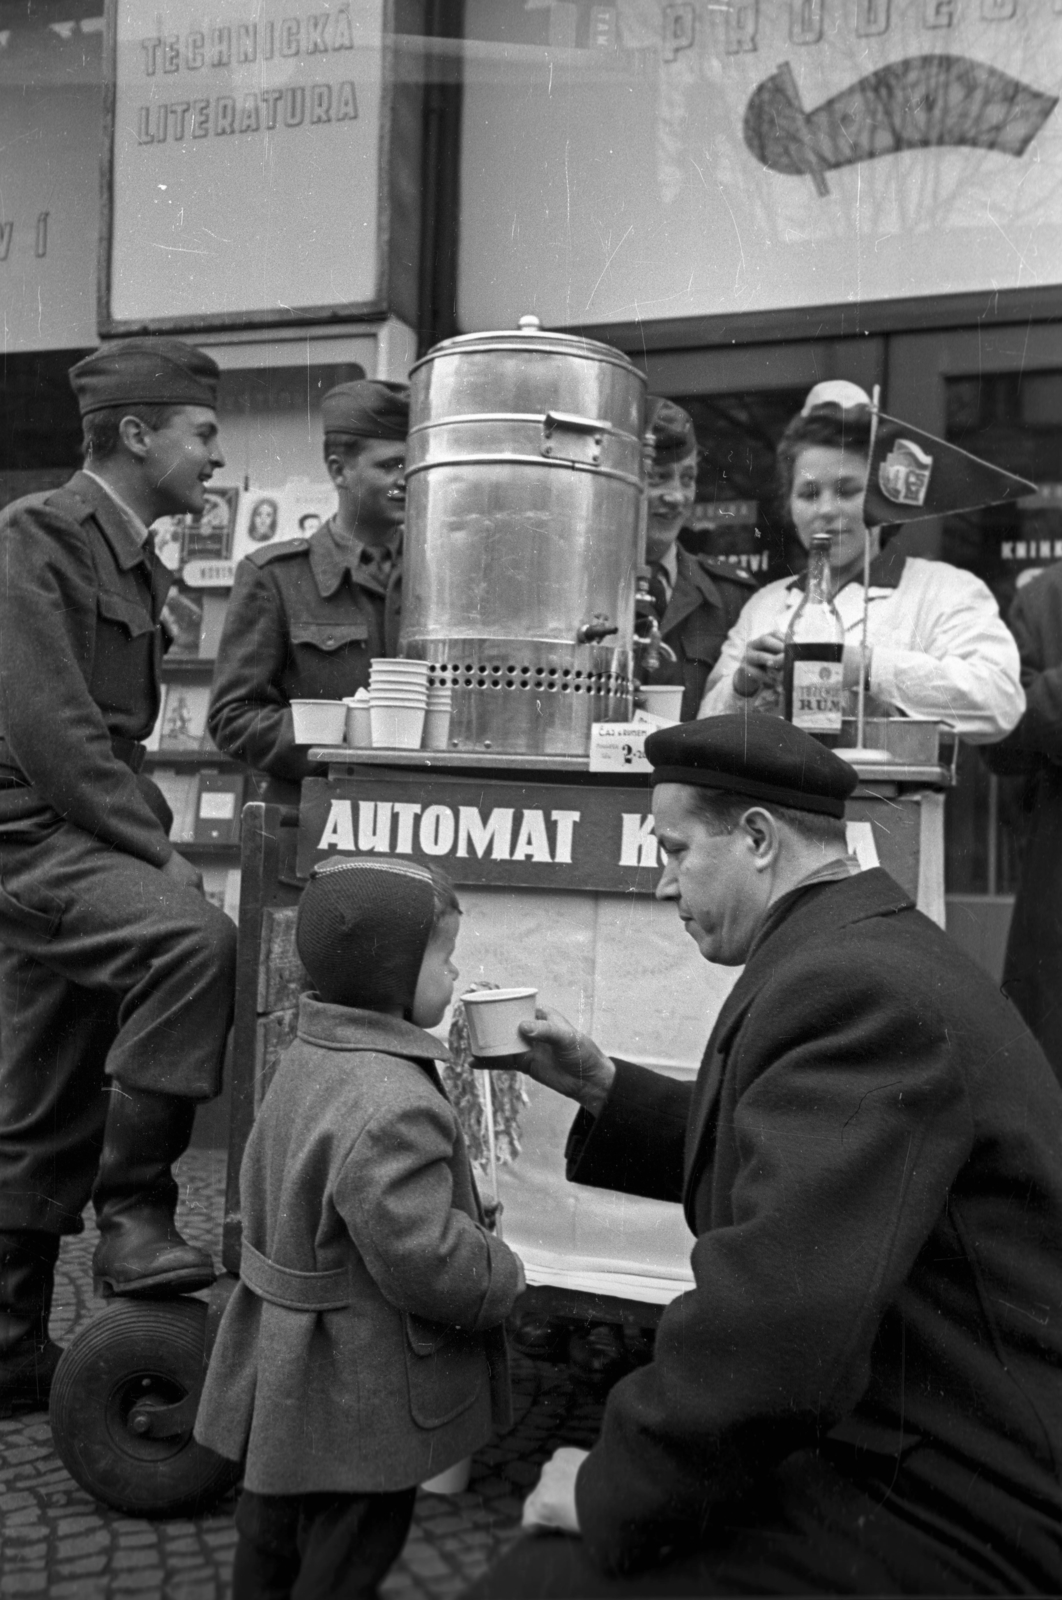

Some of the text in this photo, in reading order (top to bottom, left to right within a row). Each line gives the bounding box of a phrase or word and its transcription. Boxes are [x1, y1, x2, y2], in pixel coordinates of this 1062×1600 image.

[142, 2, 354, 76] TECHNICKÁ
[137, 80, 359, 146] LITERATURA
[799, 699, 841, 712] RUM
[316, 798, 581, 864] AUTOMAT
